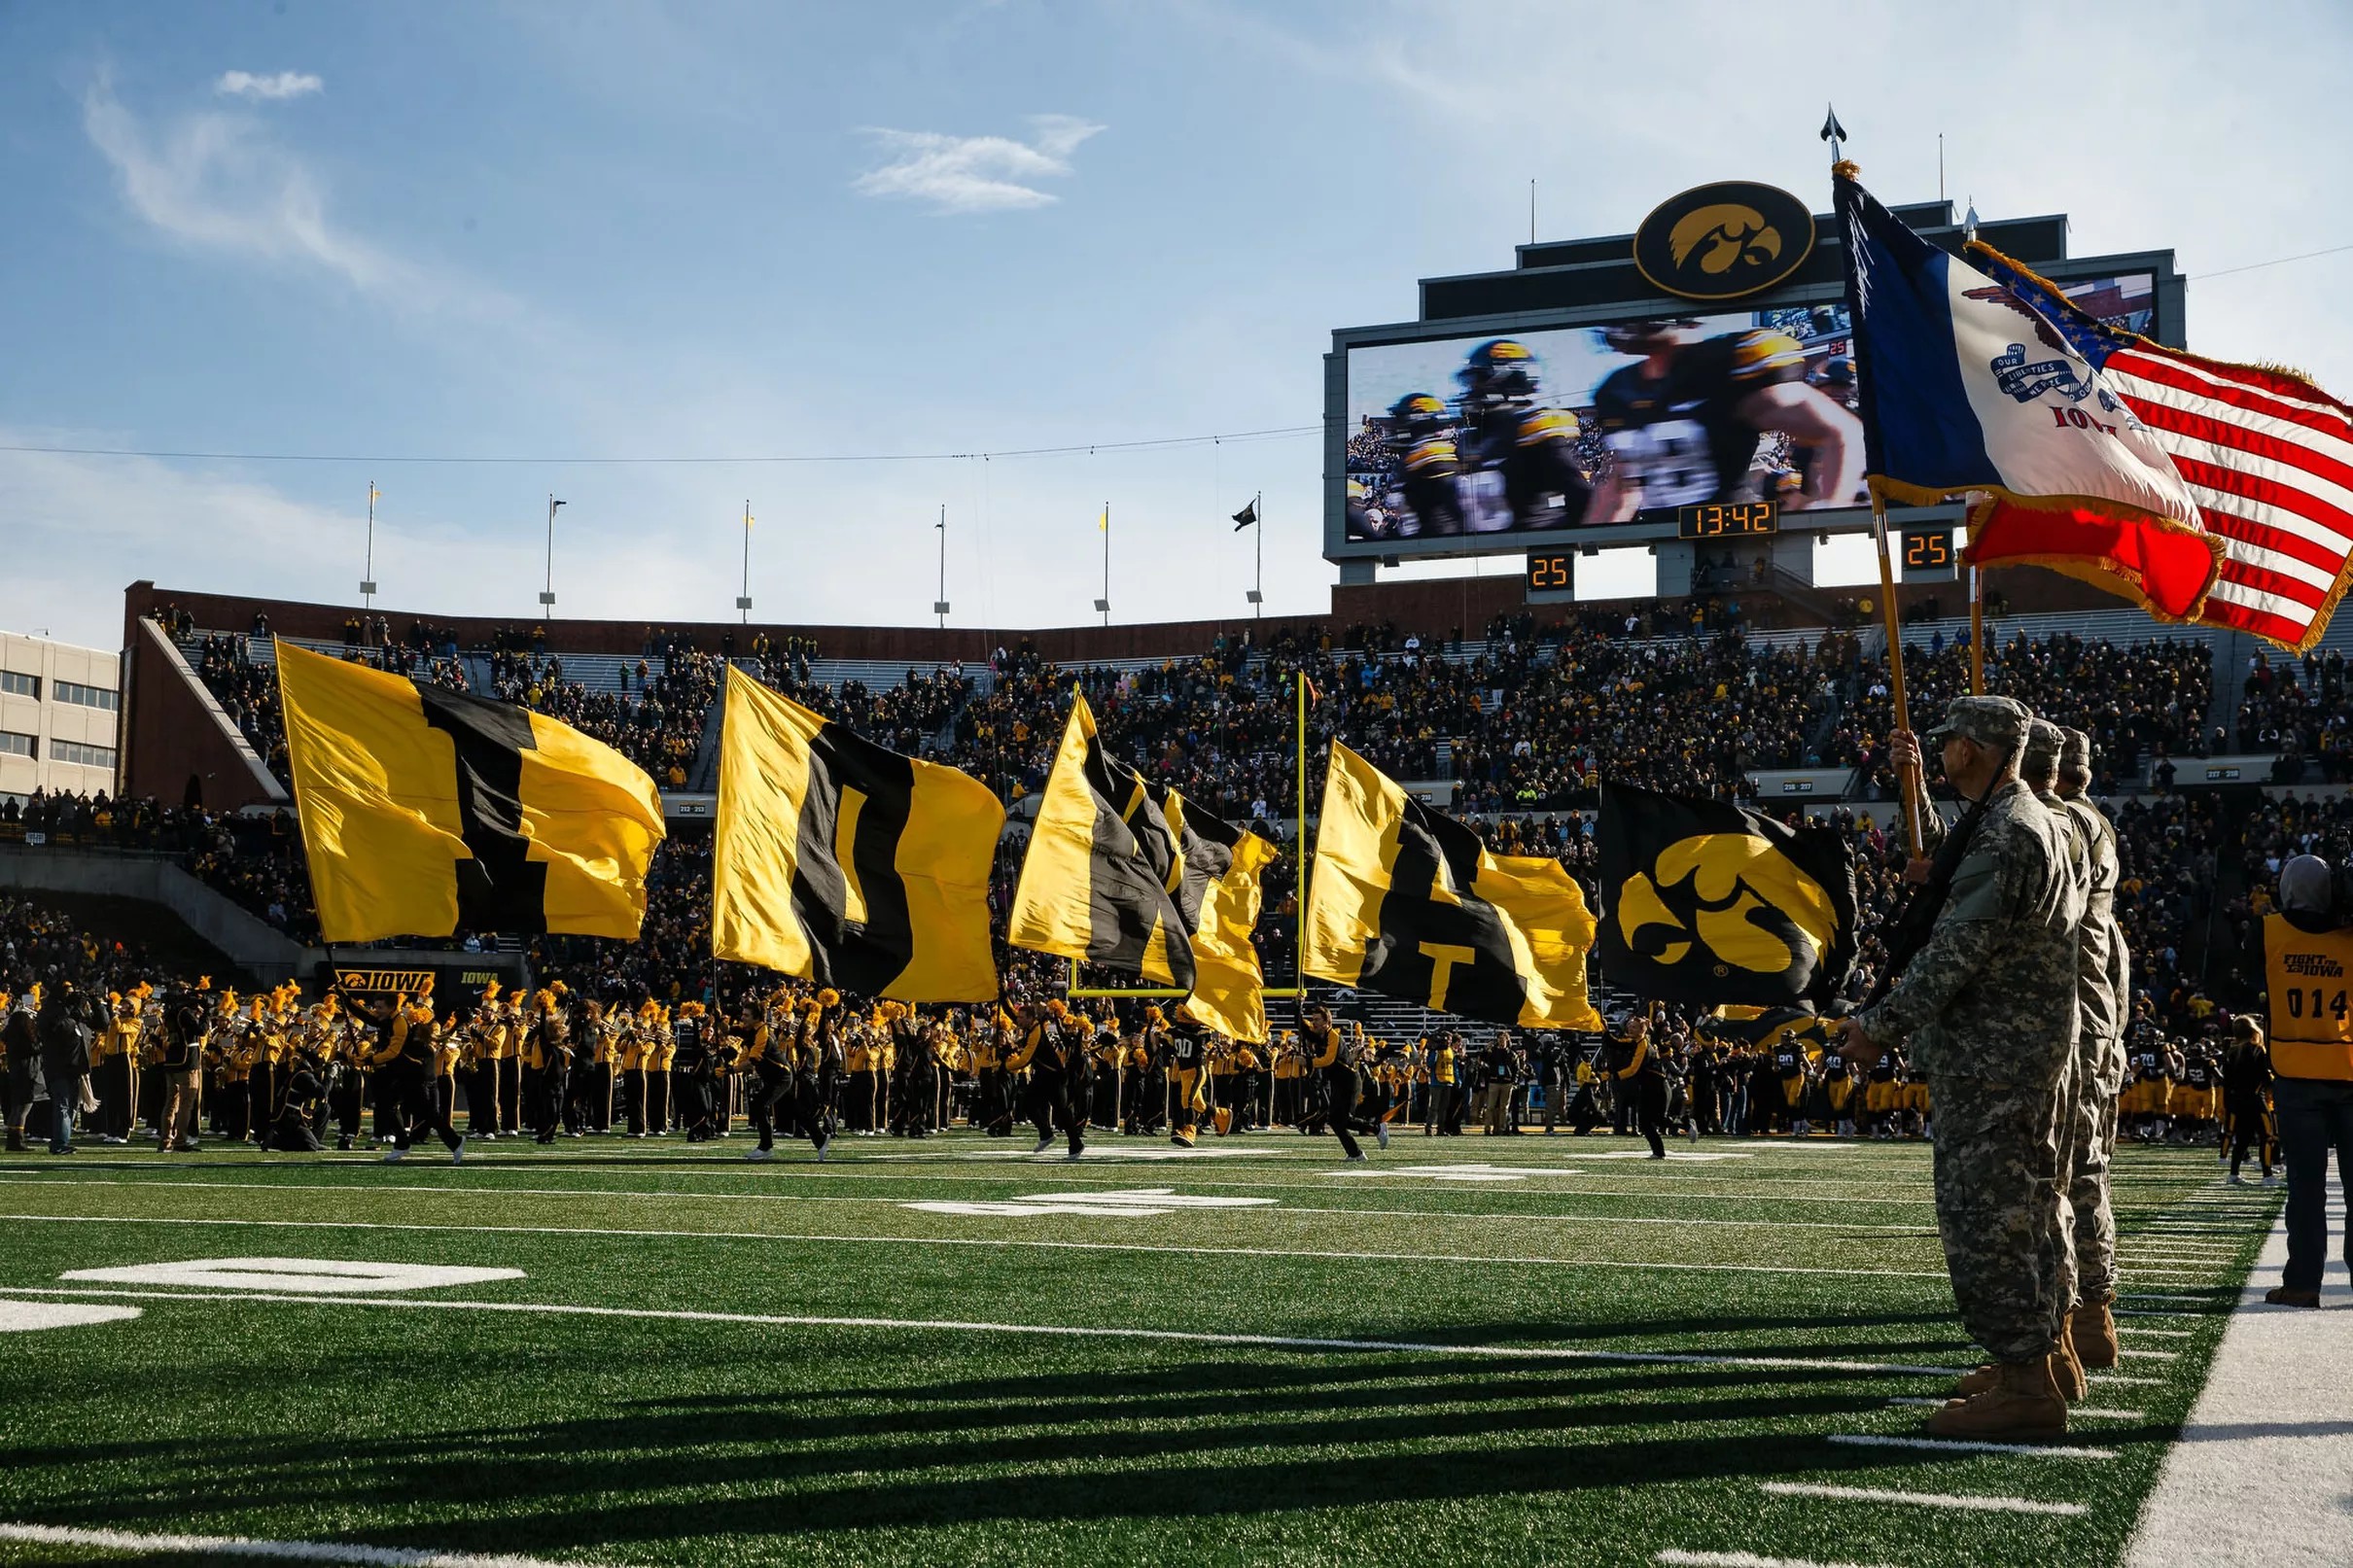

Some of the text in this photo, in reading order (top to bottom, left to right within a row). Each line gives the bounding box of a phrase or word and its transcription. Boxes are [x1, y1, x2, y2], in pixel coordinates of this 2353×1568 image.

[1997, 358, 2019, 366] OUR
[1697, 504, 1769, 534] 13:42
[1909, 536, 1945, 564] 25
[1532, 558, 1566, 586] 25
[2283, 954, 2327, 965] FIGHT
[2301, 964, 2344, 978] IOWA
[2286, 988, 2348, 1021] 014
[2140, 1053, 2156, 1067] 70
